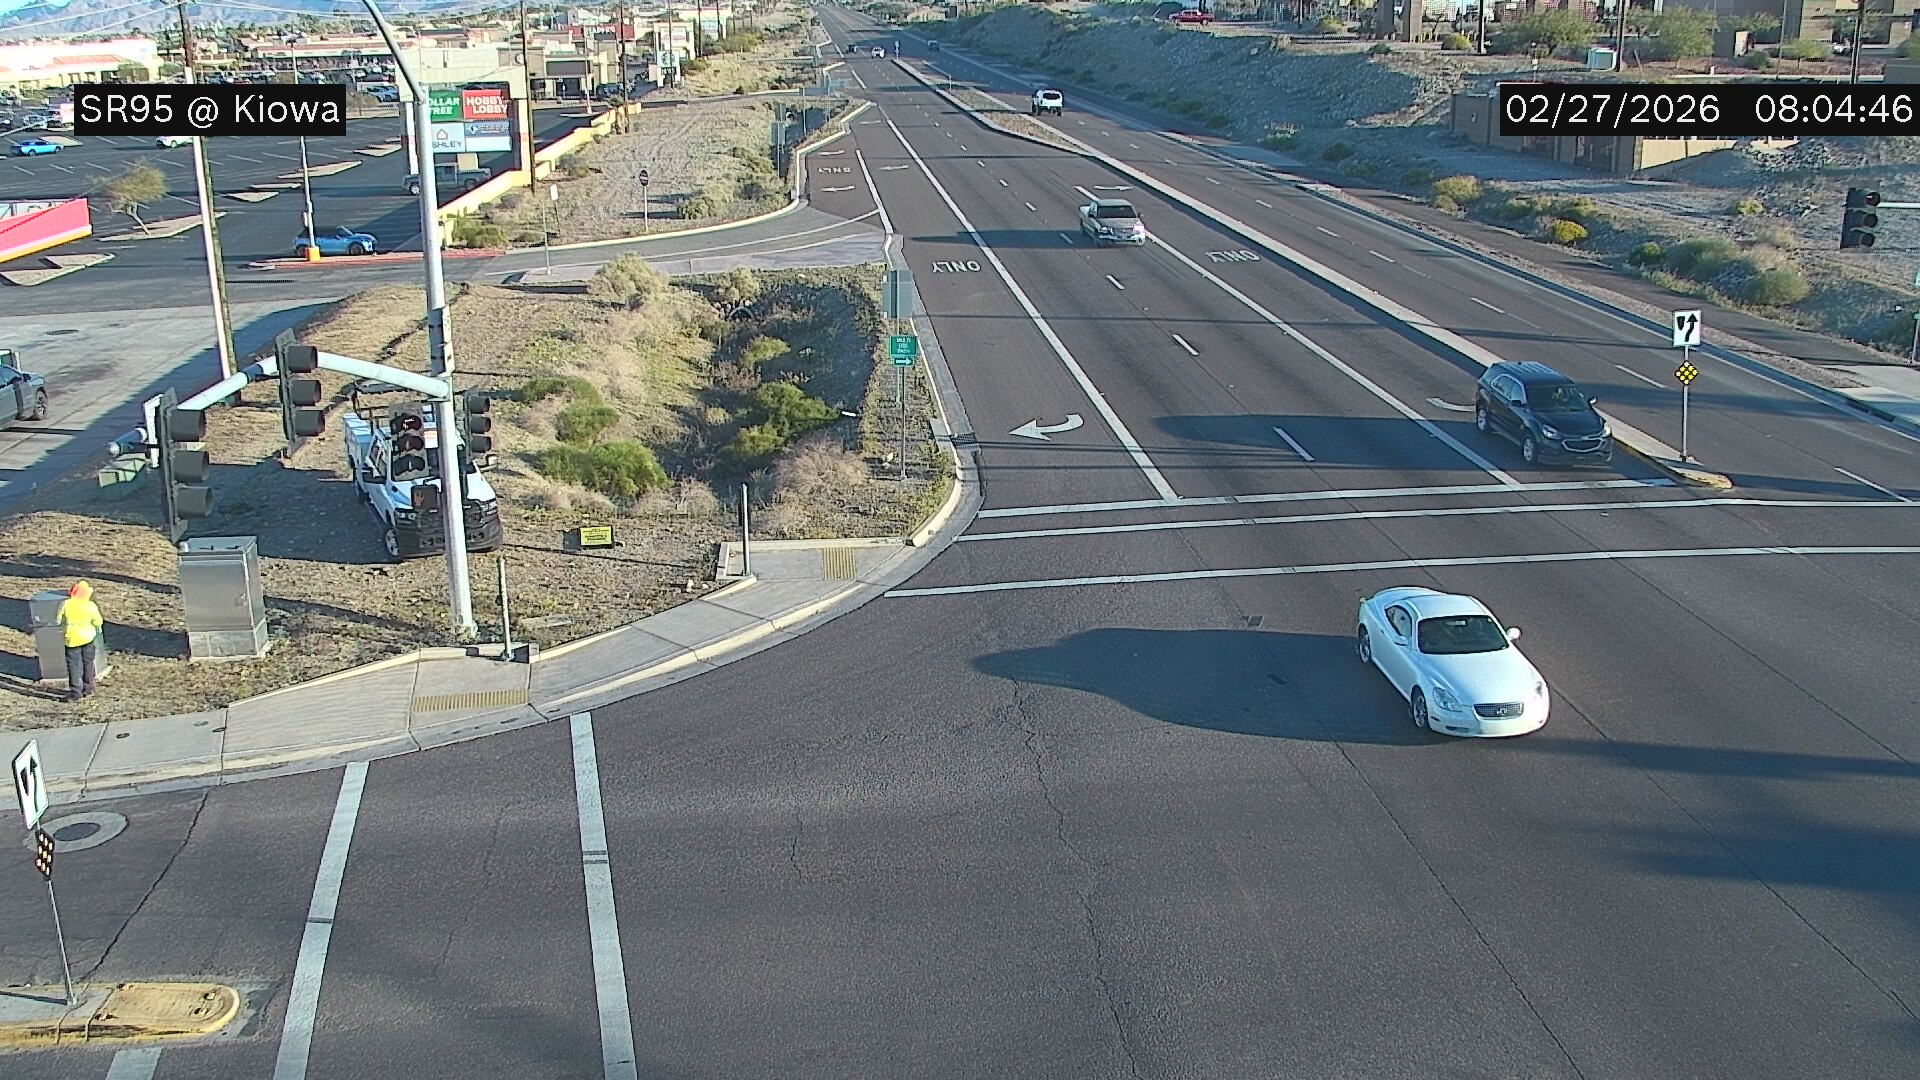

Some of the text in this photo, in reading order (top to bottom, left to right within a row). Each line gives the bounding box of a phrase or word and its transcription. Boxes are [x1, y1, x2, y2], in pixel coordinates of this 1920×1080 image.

[429, 97, 461, 106] OLLAR
[466, 96, 504, 105] HOBBY
[472, 104, 508, 114] LOBBY
[1204, 249, 1260, 263] ONLY
[931, 260, 982, 273] ONLY
